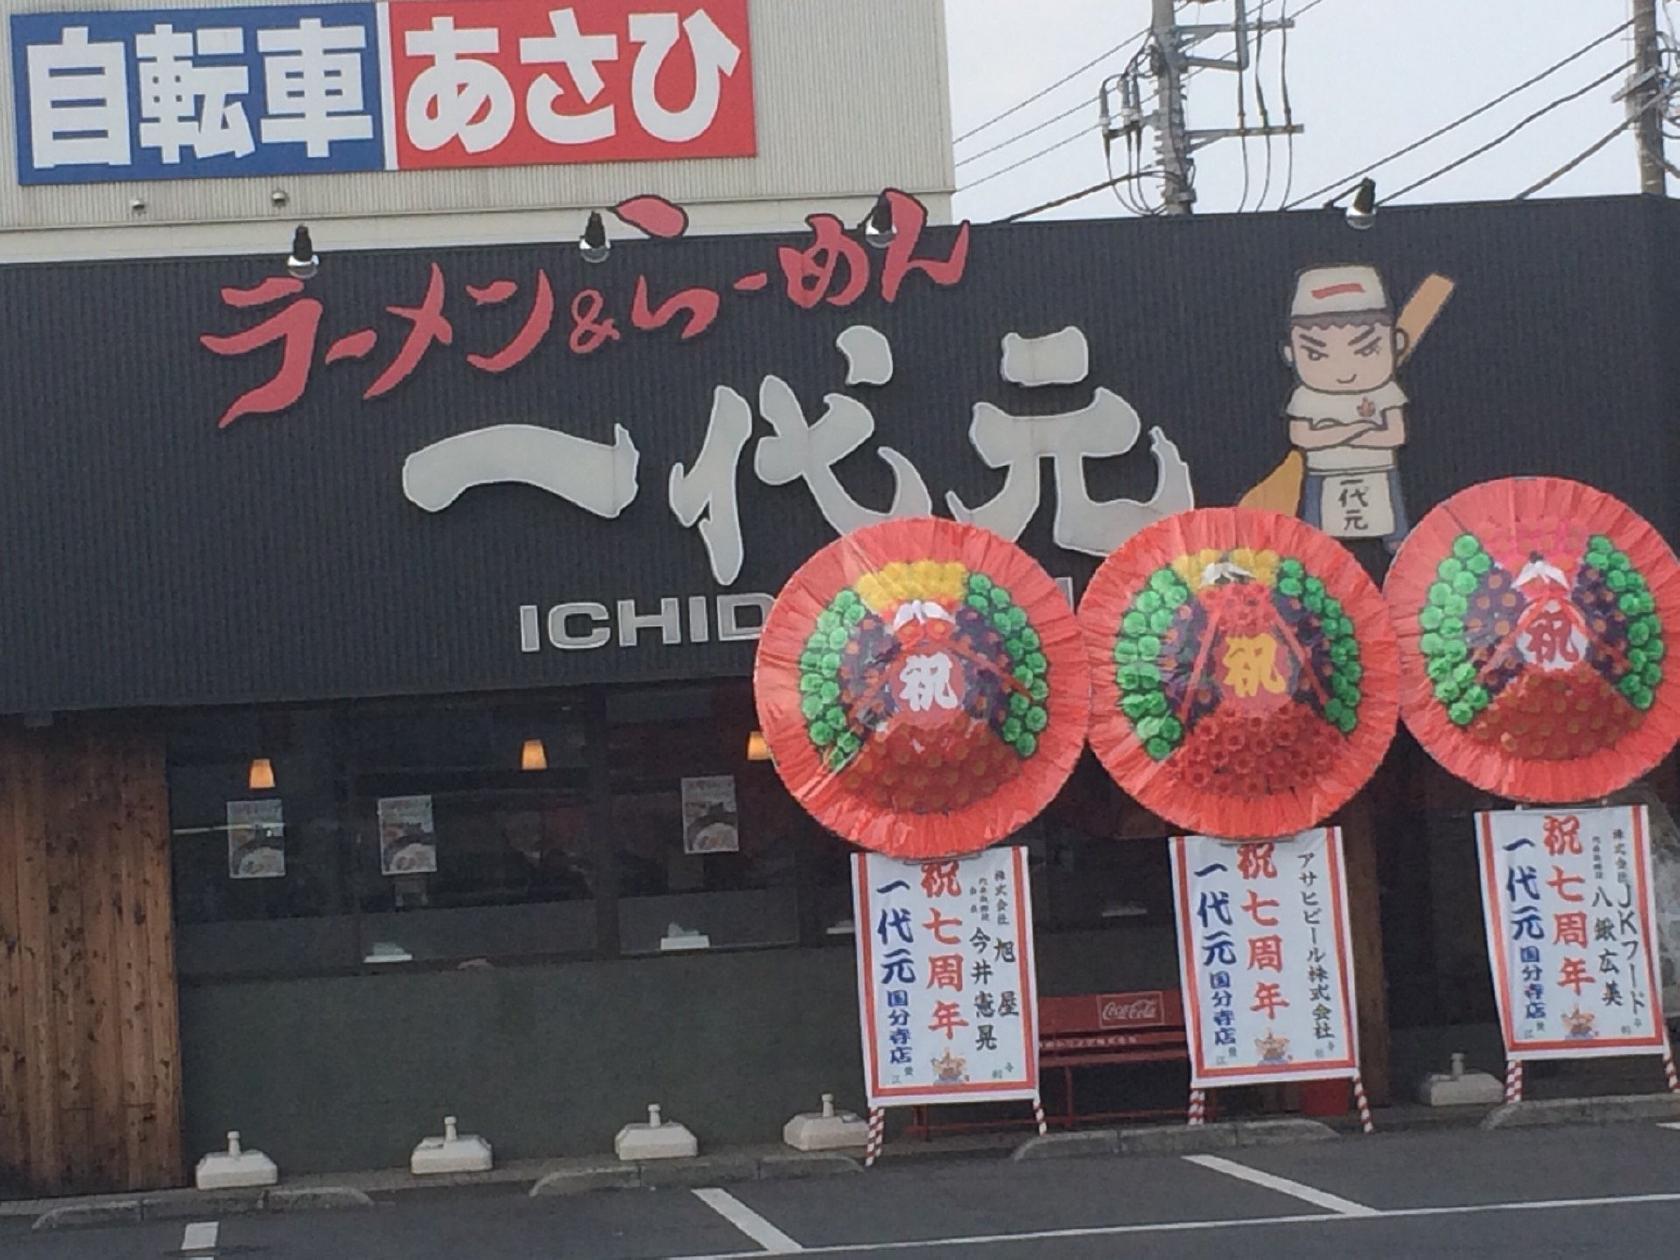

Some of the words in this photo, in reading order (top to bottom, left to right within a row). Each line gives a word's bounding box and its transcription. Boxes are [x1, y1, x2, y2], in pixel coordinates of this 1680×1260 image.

[26, 17, 374, 170] 自転車
[404, 7, 742, 154] あさひ
[401, 323, 1195, 587] 一代元
[1338, 478, 1369, 531] 一代元
[519, 592, 777, 652] ICHID
[1524, 607, 1580, 663] 祝
[899, 651, 958, 712] 祝
[1223, 632, 1286, 698] 祝
[1542, 814, 1597, 997] 祝七周年
